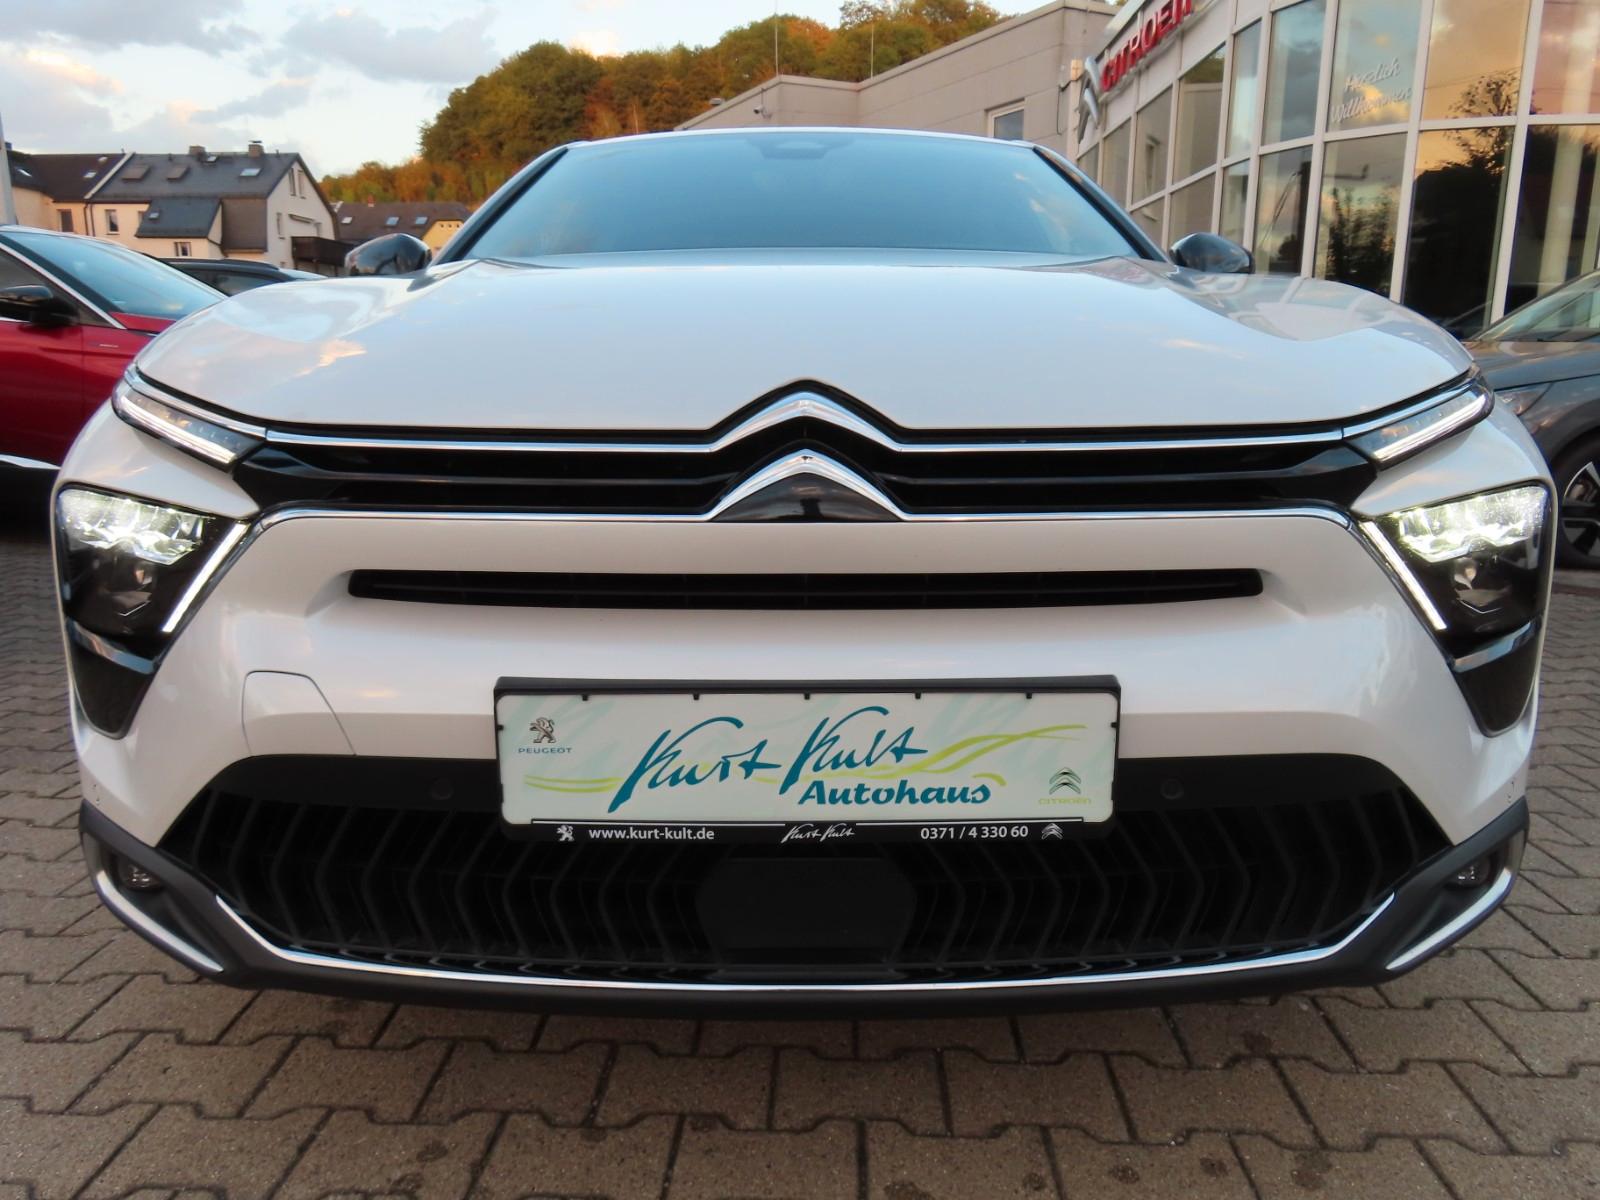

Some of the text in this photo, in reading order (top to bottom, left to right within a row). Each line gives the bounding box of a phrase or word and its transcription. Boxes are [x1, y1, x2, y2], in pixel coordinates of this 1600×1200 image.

[607, 705, 929, 813] Kurt Kult
[798, 779, 992, 805] Autohaus
[588, 826, 715, 840] www.kurt-kult.de
[780, 822, 856, 844] Kurt Kult
[920, 827, 955, 839] 0371
[981, 826, 1007, 838] 330
[1010, 825, 1029, 838] 60
